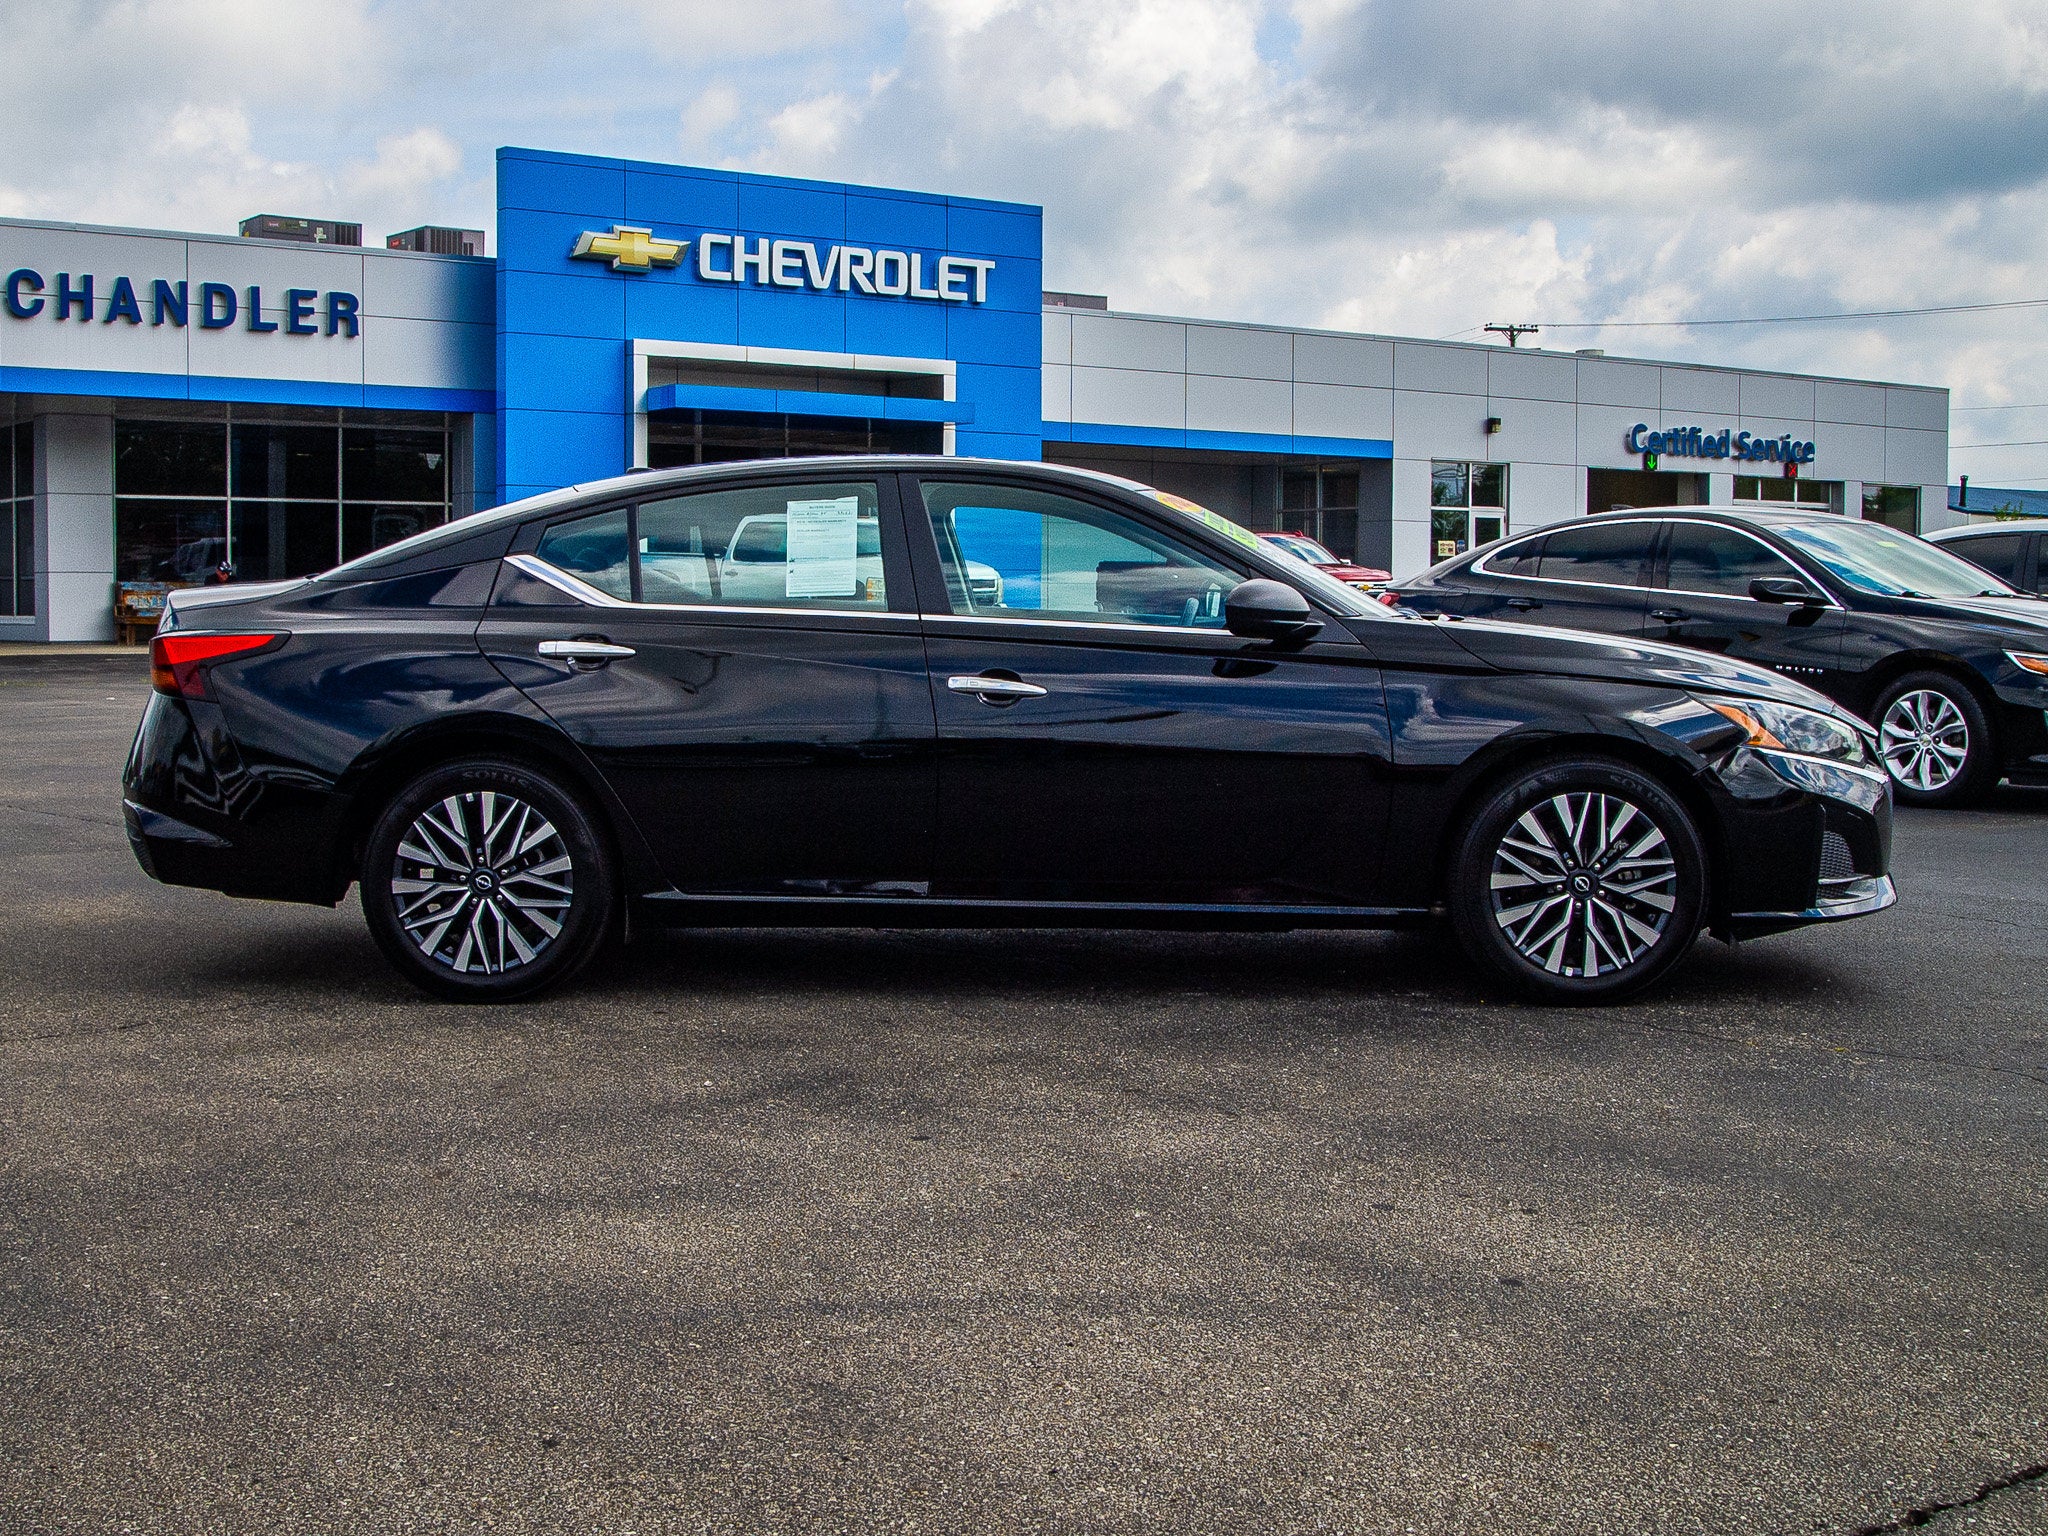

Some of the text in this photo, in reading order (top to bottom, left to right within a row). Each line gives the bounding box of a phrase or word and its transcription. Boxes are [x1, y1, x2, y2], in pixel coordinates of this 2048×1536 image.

[698, 232, 995, 303] CHEVROLET
[6, 268, 360, 338] CHANDLER
[1630, 423, 1816, 463] Certified Service
